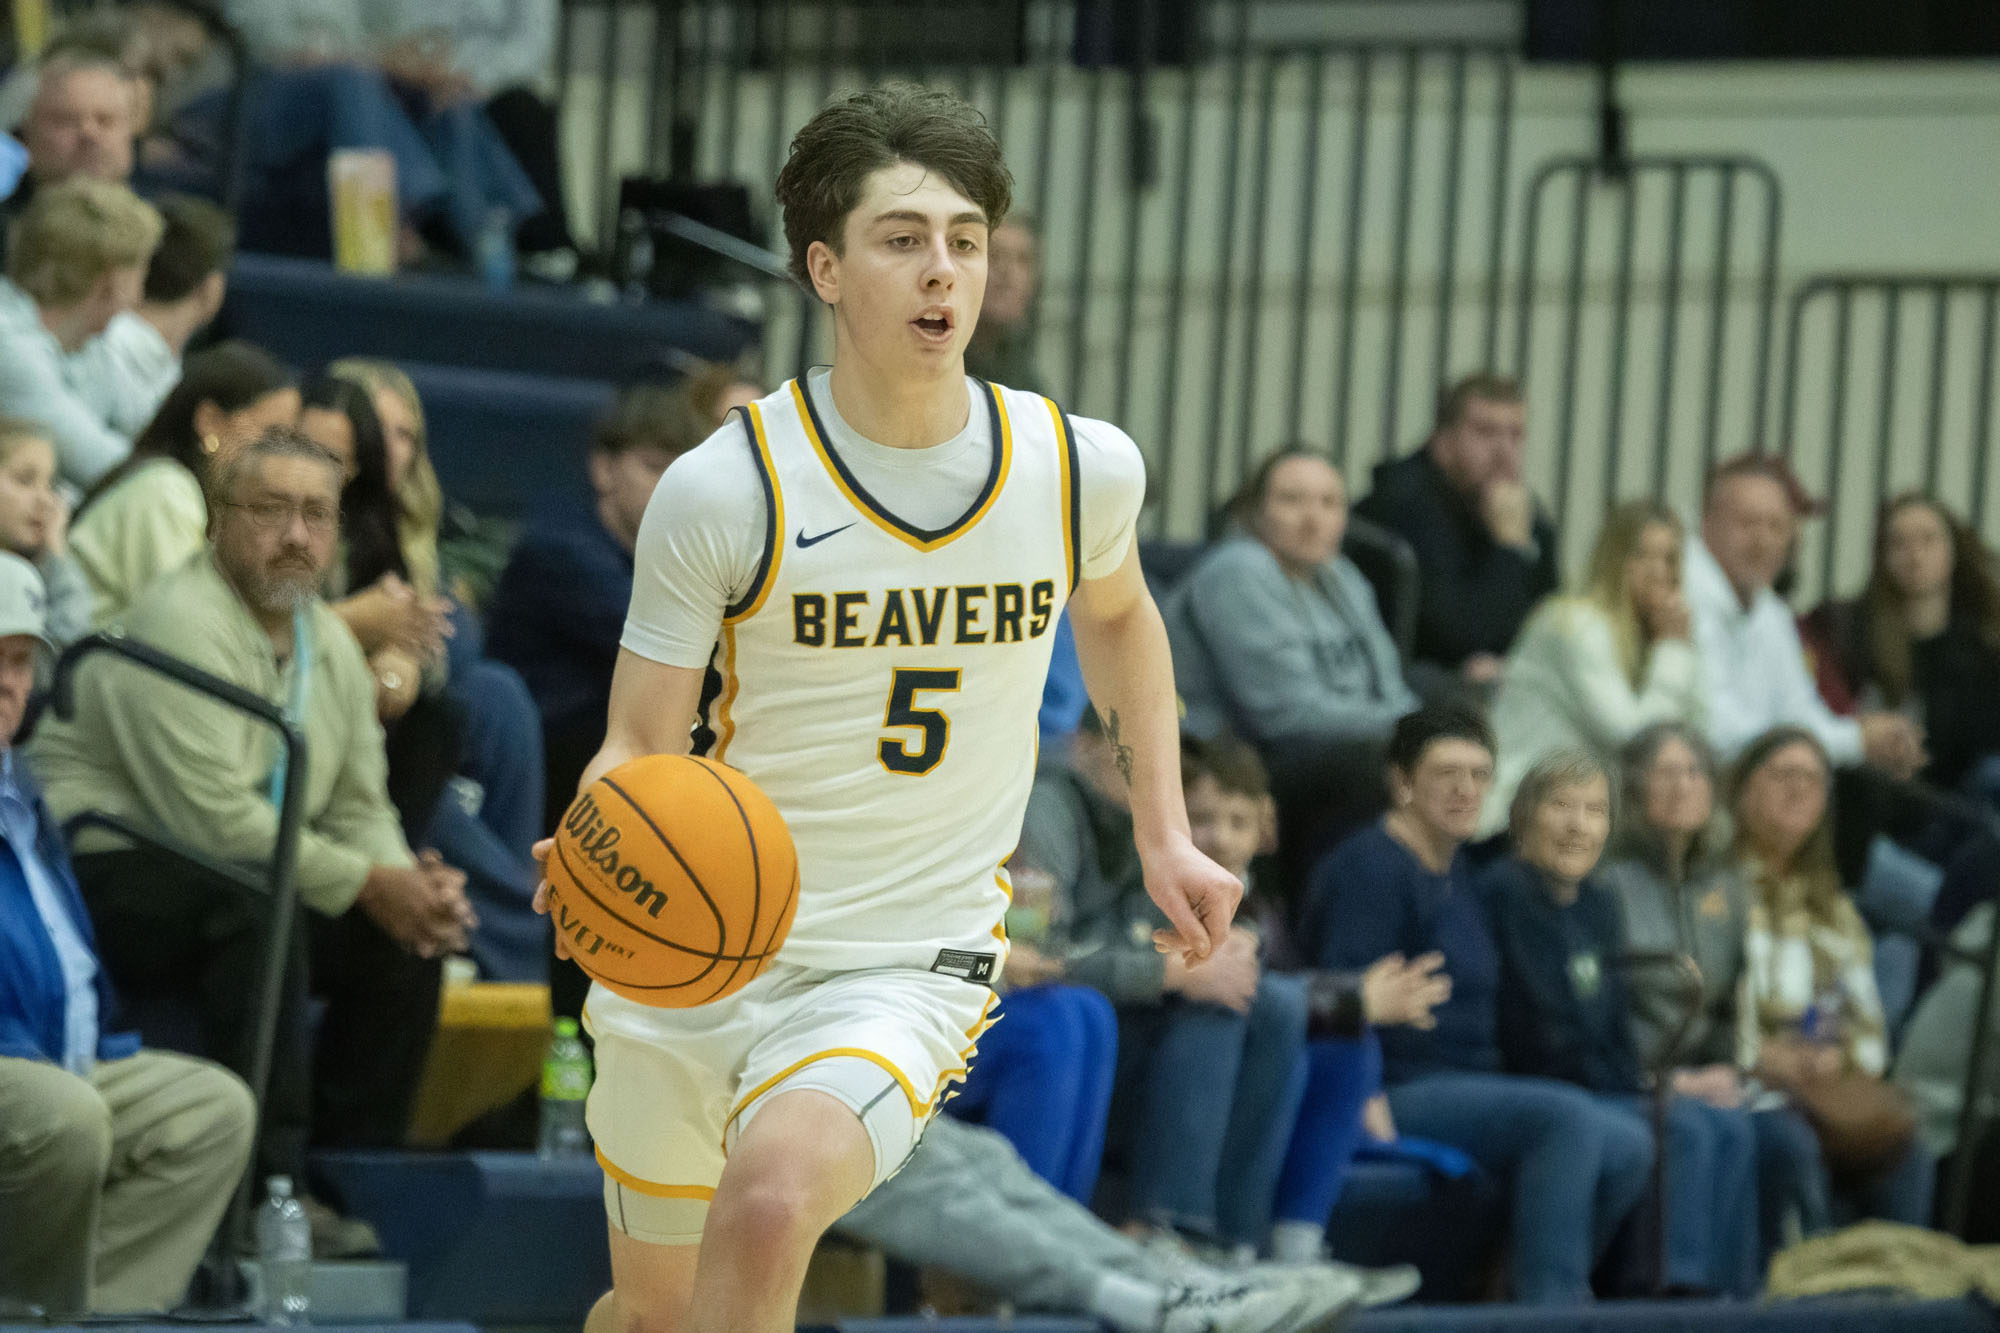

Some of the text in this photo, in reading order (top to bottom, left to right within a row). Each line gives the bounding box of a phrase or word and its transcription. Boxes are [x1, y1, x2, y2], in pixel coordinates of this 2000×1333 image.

[791, 577, 1055, 648] BEAVERS
[876, 666, 964, 777] 5
[565, 793, 669, 920] Wilson
[976, 962, 990, 976] M
